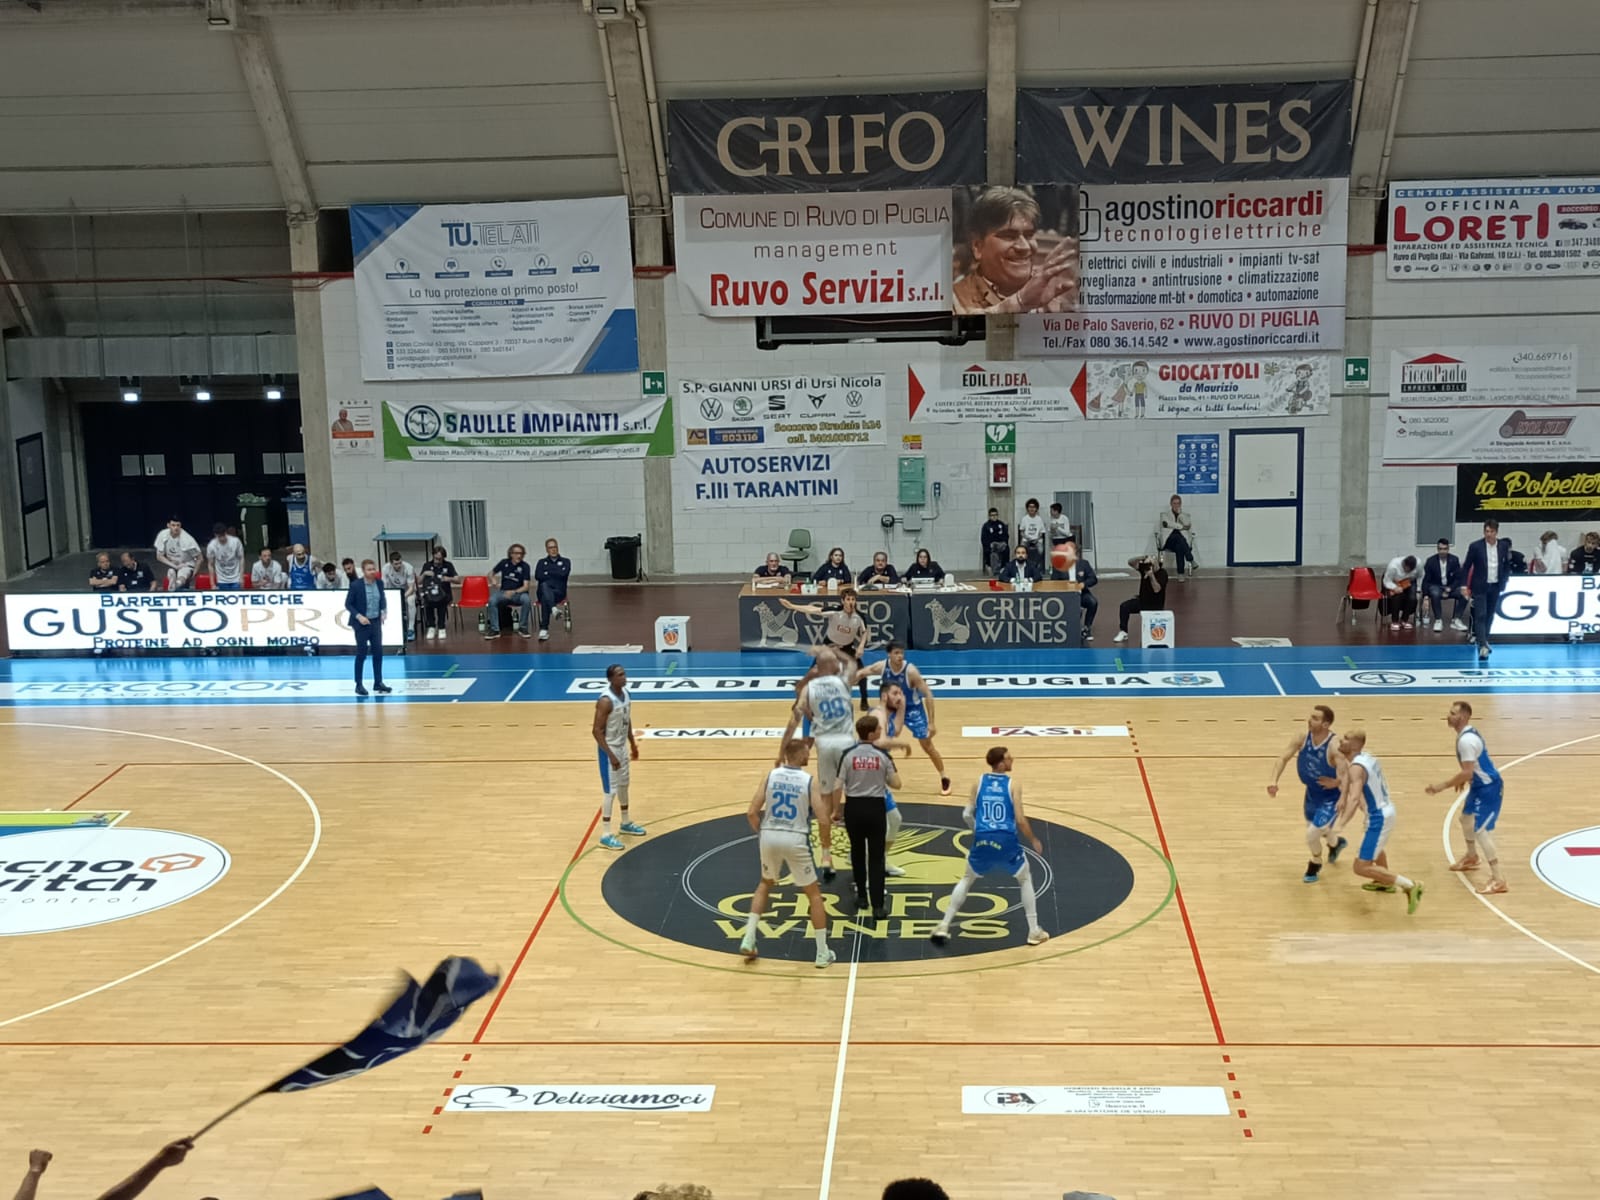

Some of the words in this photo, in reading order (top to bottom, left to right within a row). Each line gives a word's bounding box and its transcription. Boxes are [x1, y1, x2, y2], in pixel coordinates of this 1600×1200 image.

[717, 111, 945, 177] GRIFO
[1060, 100, 1312, 168] WINES
[1397, 189, 1454, 197] CENTRO
[1461, 187, 1550, 196] ASSISTENZA
[1558, 186, 1595, 194] AUTO
[1105, 190, 1323, 226] agostinoriccardi
[1425, 200, 1520, 212] OFFICINA
[700, 207, 777, 229] COMUNE
[784, 211, 799, 227] DI
[807, 205, 857, 226] RUVO
[863, 208, 878, 225] DI
[885, 203, 950, 225] PUGLIA
[1394, 202, 1549, 242] LORETI
[1105, 223, 1321, 244] tecnologielettriche
[754, 240, 897, 262] management
[1394, 243, 1447, 251] RIPARAZIONE
[1516, 240, 1548, 248] TECNICA
[1088, 255, 1127, 270] elettrici
[1132, 254, 1156, 269] civili
[1161, 257, 1167, 268] e
[1171, 253, 1223, 269] industriali
[1239, 252, 1283, 269] impianti
[1289, 251, 1320, 265] tv-sat
[710, 273, 788, 306] Ruvo
[802, 269, 904, 305] Servizi
[908, 283, 944, 301] s.r.l.
[1152, 273, 1222, 288] antintrusione
[1238, 270, 1320, 286] climatizzazione
[409, 288, 422, 299] La
[425, 287, 442, 299] tua
[444, 286, 498, 300] protezione
[515, 283, 545, 298] primo
[547, 282, 579, 297] posto!
[1087, 290, 1157, 305] trasformazione
[1159, 290, 1186, 304] mt-bt
[1197, 289, 1243, 303] domotica
[1255, 287, 1319, 302] automazione
[1043, 319, 1061, 331] Via
[1065, 319, 1080, 331] De
[1083, 319, 1107, 331] Palo
[1111, 318, 1157, 332] Saverio,
[1160, 318, 1174, 330] 62
[1189, 312, 1233, 330] RUVO
[1239, 312, 1255, 328] DI
[1261, 310, 1320, 327] PUGLIA
[1043, 336, 1085, 349] Tel./Fax
[1090, 336, 1110, 348] 080
[1114, 335, 1168, 348] 36.14.542
[1184, 332, 1320, 349] www.agostinoriccardi.it
[1159, 363, 1259, 381] GIOCATTOLI
[683, 382, 704, 393] S.P.
[708, 381, 756, 393] GIANNI
[761, 379, 791, 391] URSI
[795, 379, 807, 389] di
[811, 377, 836, 388] Ursi
[841, 376, 881, 388] Nicola
[1179, 383, 1192, 393] da
[1195, 382, 1239, 392] Maurizio
[1404, 384, 1437, 392] IMPRESA
[445, 412, 516, 433] SAULLE
[522, 413, 618, 434] IMPIANTI
[623, 418, 651, 431] s.r.l.
[701, 455, 830, 475] AUTOSERVIZI
[734, 479, 838, 498] TARANTINI
[1475, 472, 1497, 495] la
[101, 594, 196, 607] BARRETTE
[202, 593, 304, 606] PROTEICHE
[977, 597, 1066, 621] GRIFO
[93, 636, 169, 648] PROTEINE
[182, 637, 203, 647] AD
[216, 637, 253, 647] OGNI
[267, 636, 320, 647] MORSO
[976, 621, 1077, 644] WINES
[16, 681, 309, 693] FERCOLOR
[716, 679, 760, 689] DI
[977, 676, 1151, 686] PUGLIA
[772, 791, 799, 820] 25
[982, 801, 1006, 823] 10
[713, 919, 1010, 939] WINES
[533, 1090, 707, 1107] Deliziamoci
